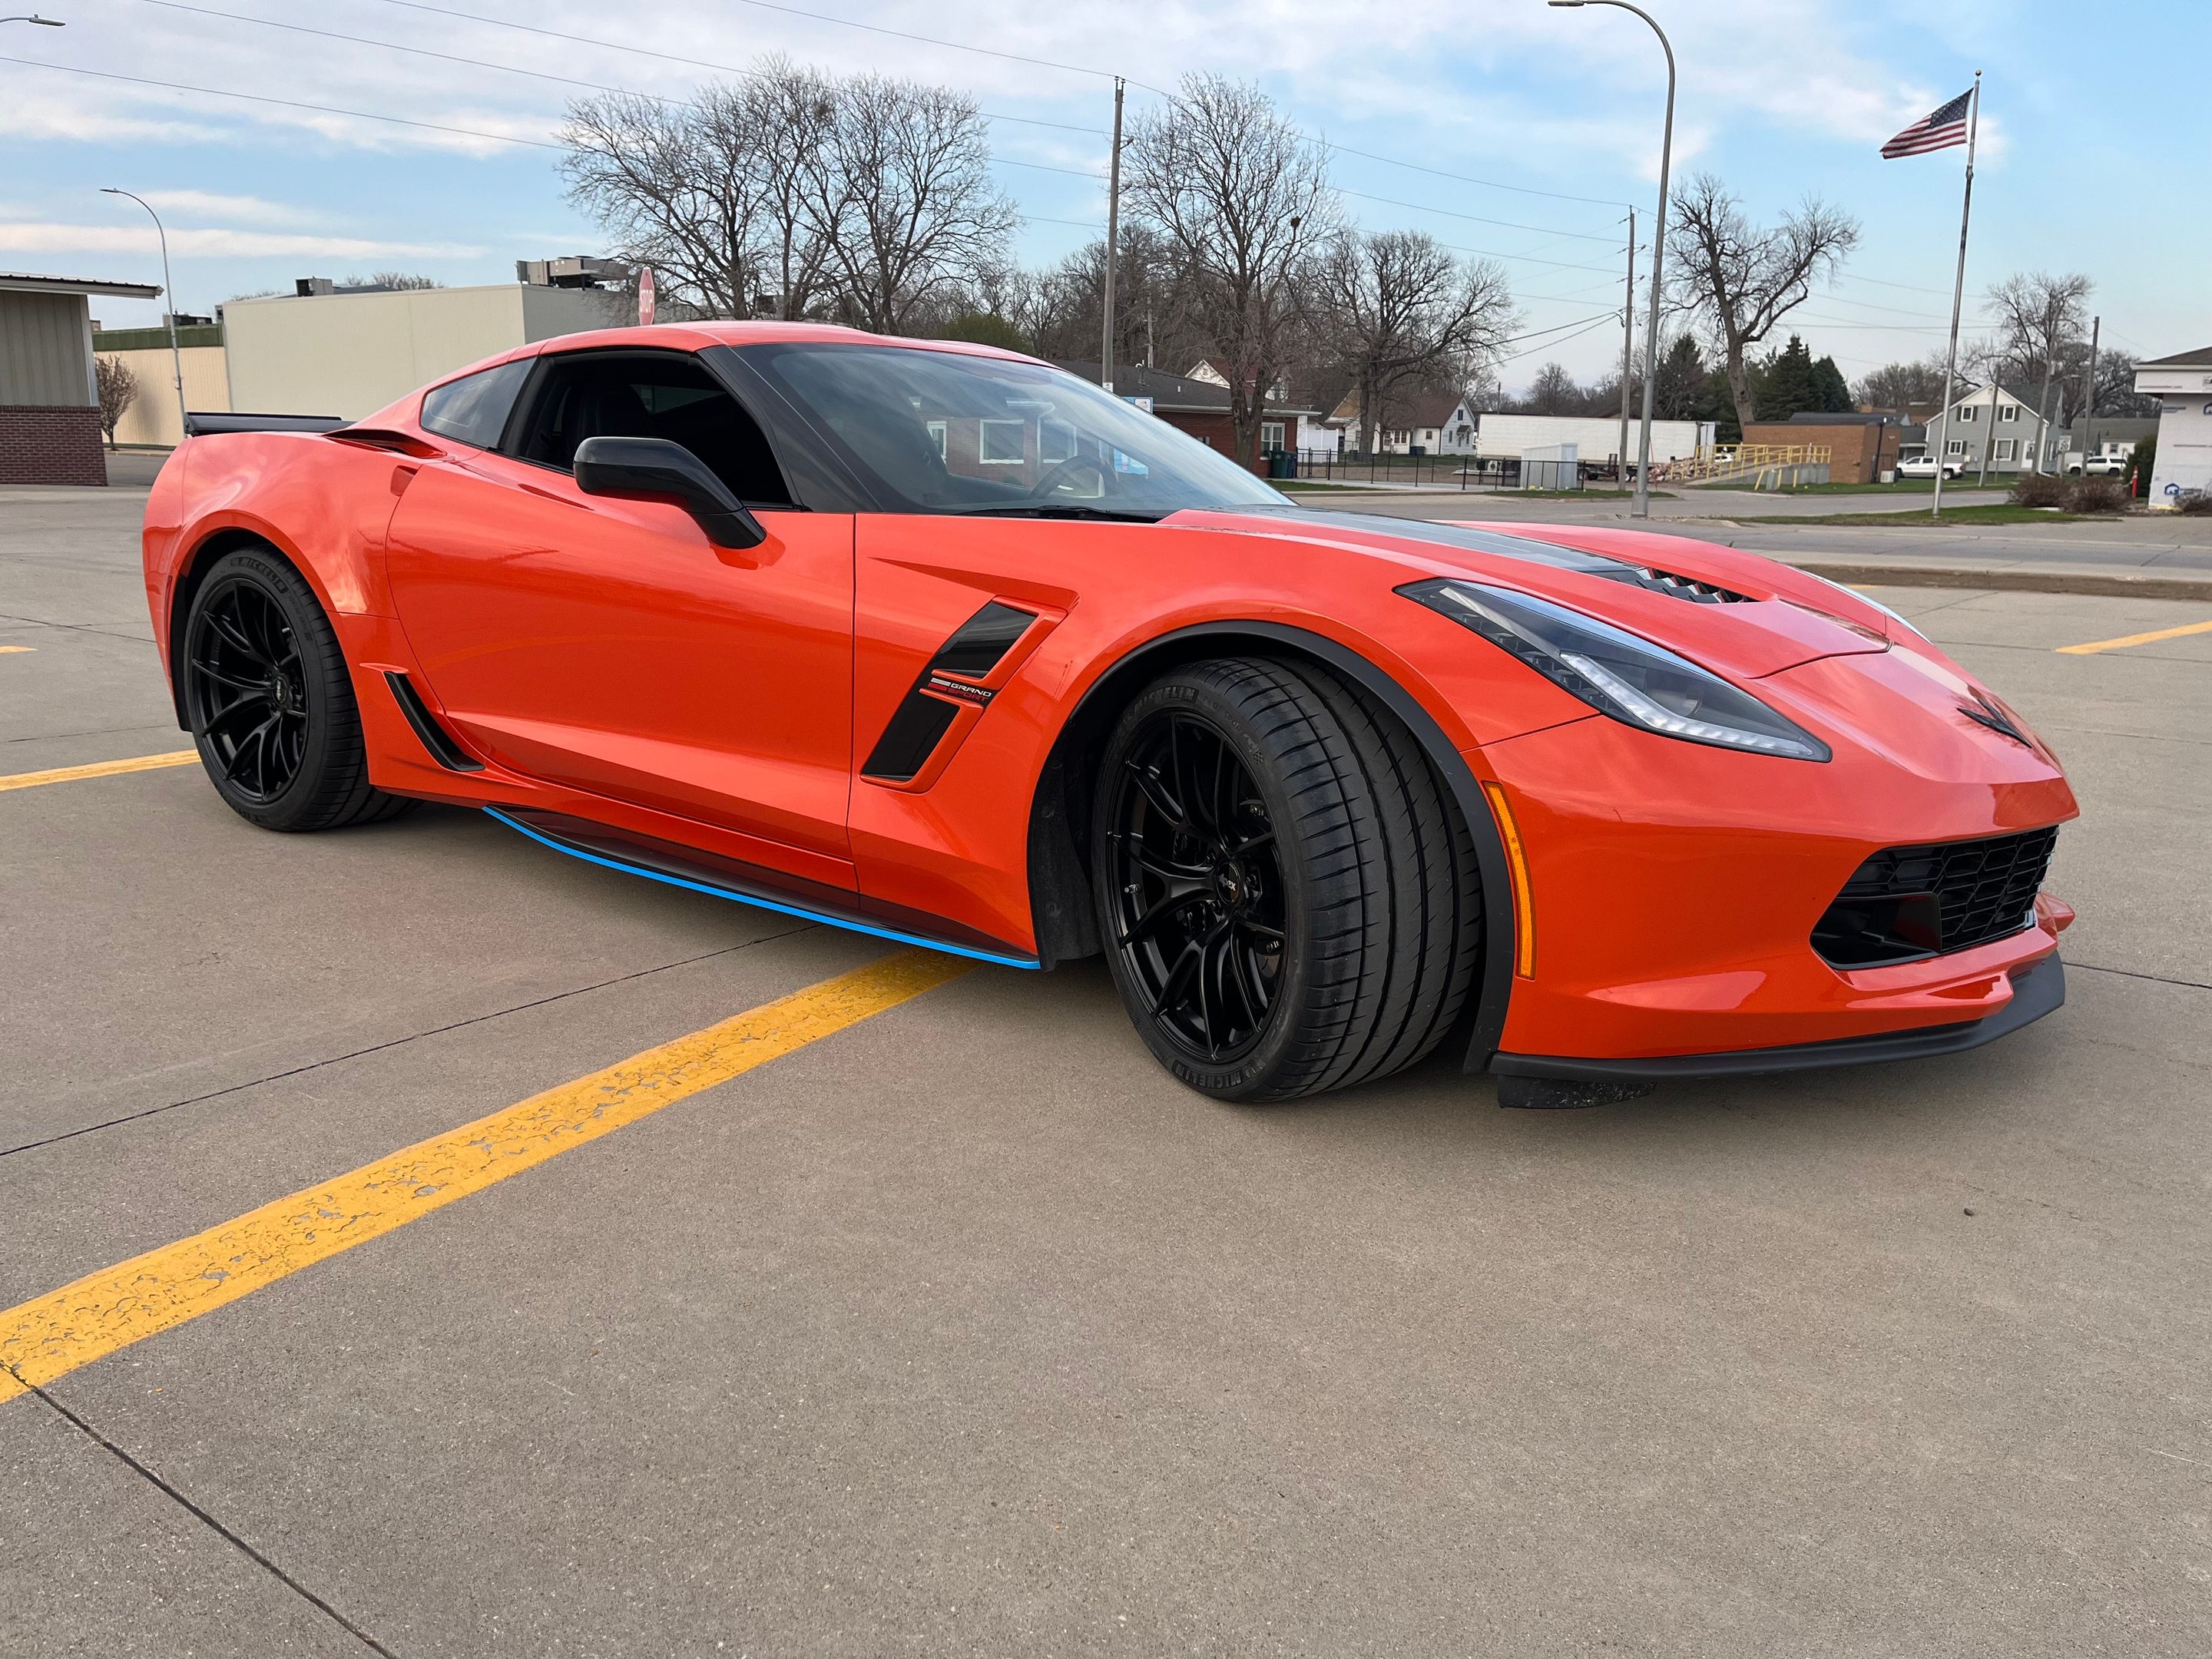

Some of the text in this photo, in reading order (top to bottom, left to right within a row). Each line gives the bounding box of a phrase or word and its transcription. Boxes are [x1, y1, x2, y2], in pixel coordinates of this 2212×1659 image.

[640, 289, 653, 313] STOP
[947, 687, 989, 701] SPORT
[950, 683, 992, 697] GRAND
[1174, 1064, 1241, 1088] MICHELIN
